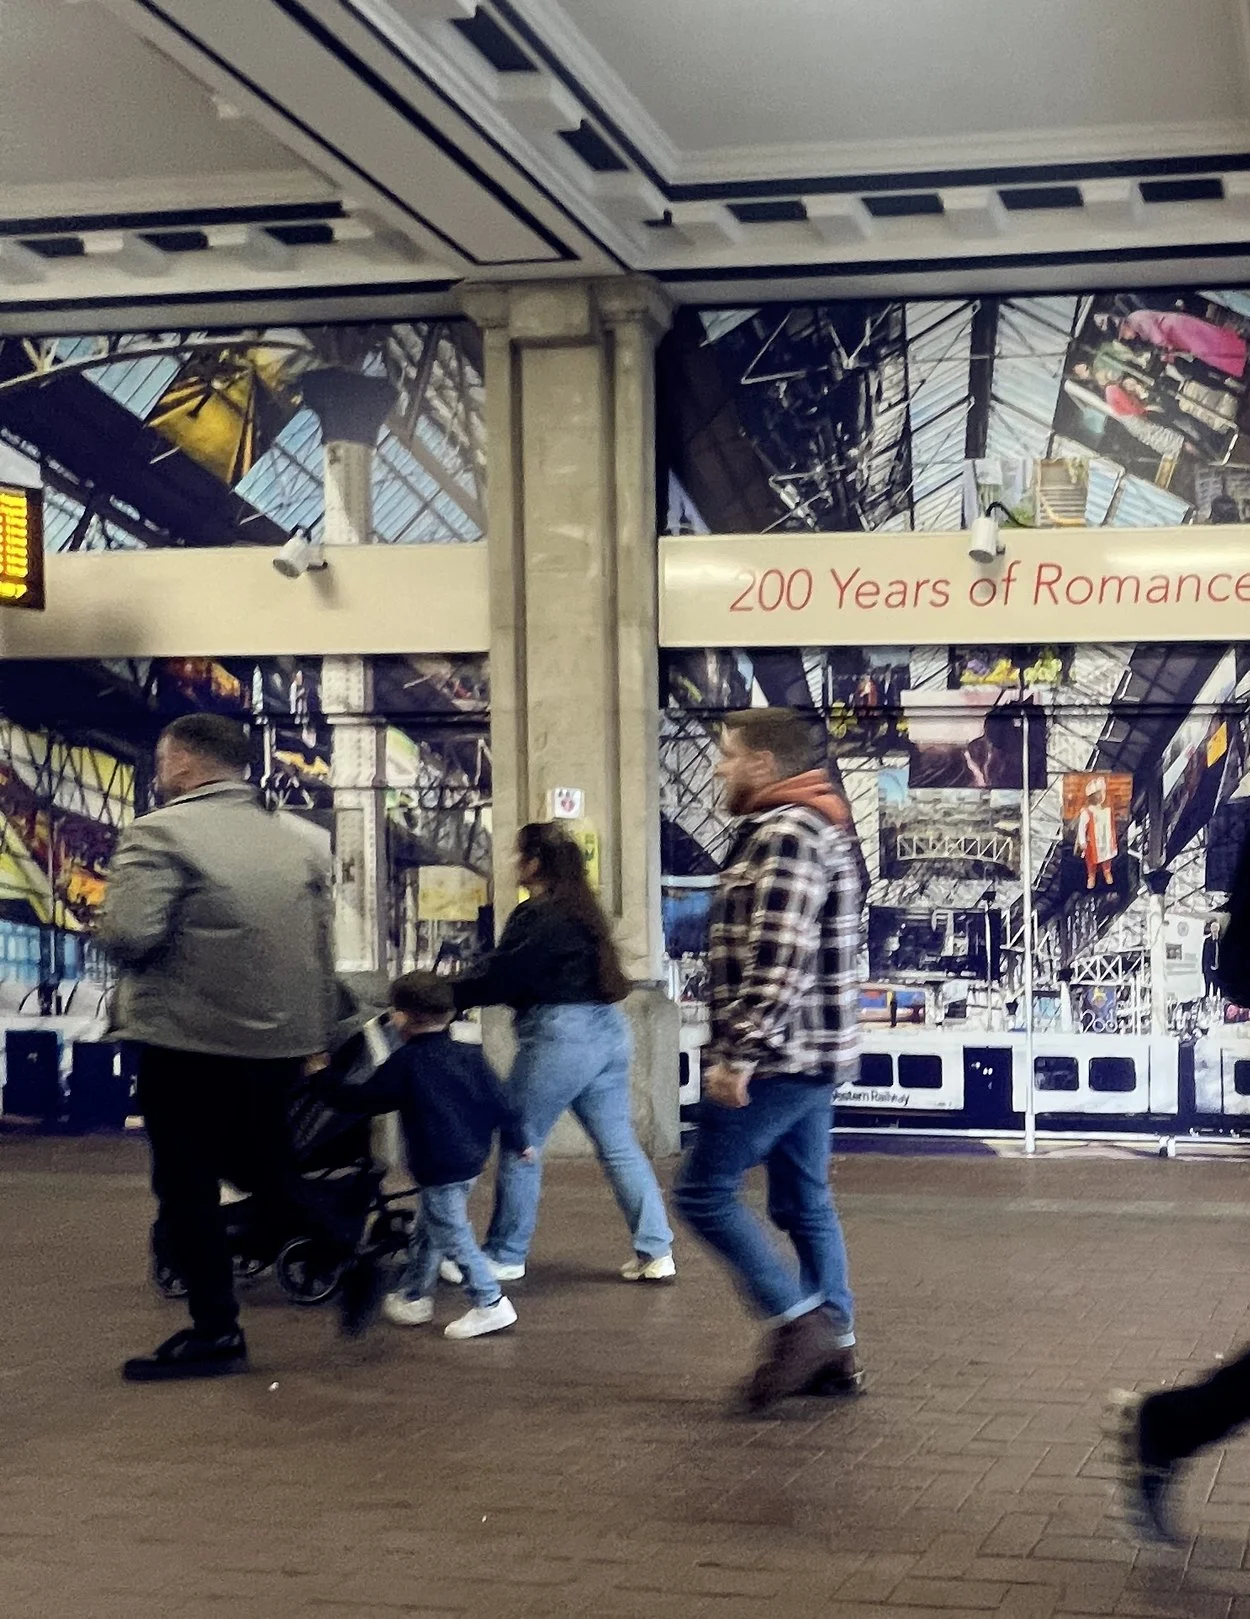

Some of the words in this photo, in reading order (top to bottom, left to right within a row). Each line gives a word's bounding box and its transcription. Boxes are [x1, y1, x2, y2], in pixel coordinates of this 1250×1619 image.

[728, 567, 814, 613] 200
[830, 566, 951, 610] Years
[968, 559, 1022, 608] of
